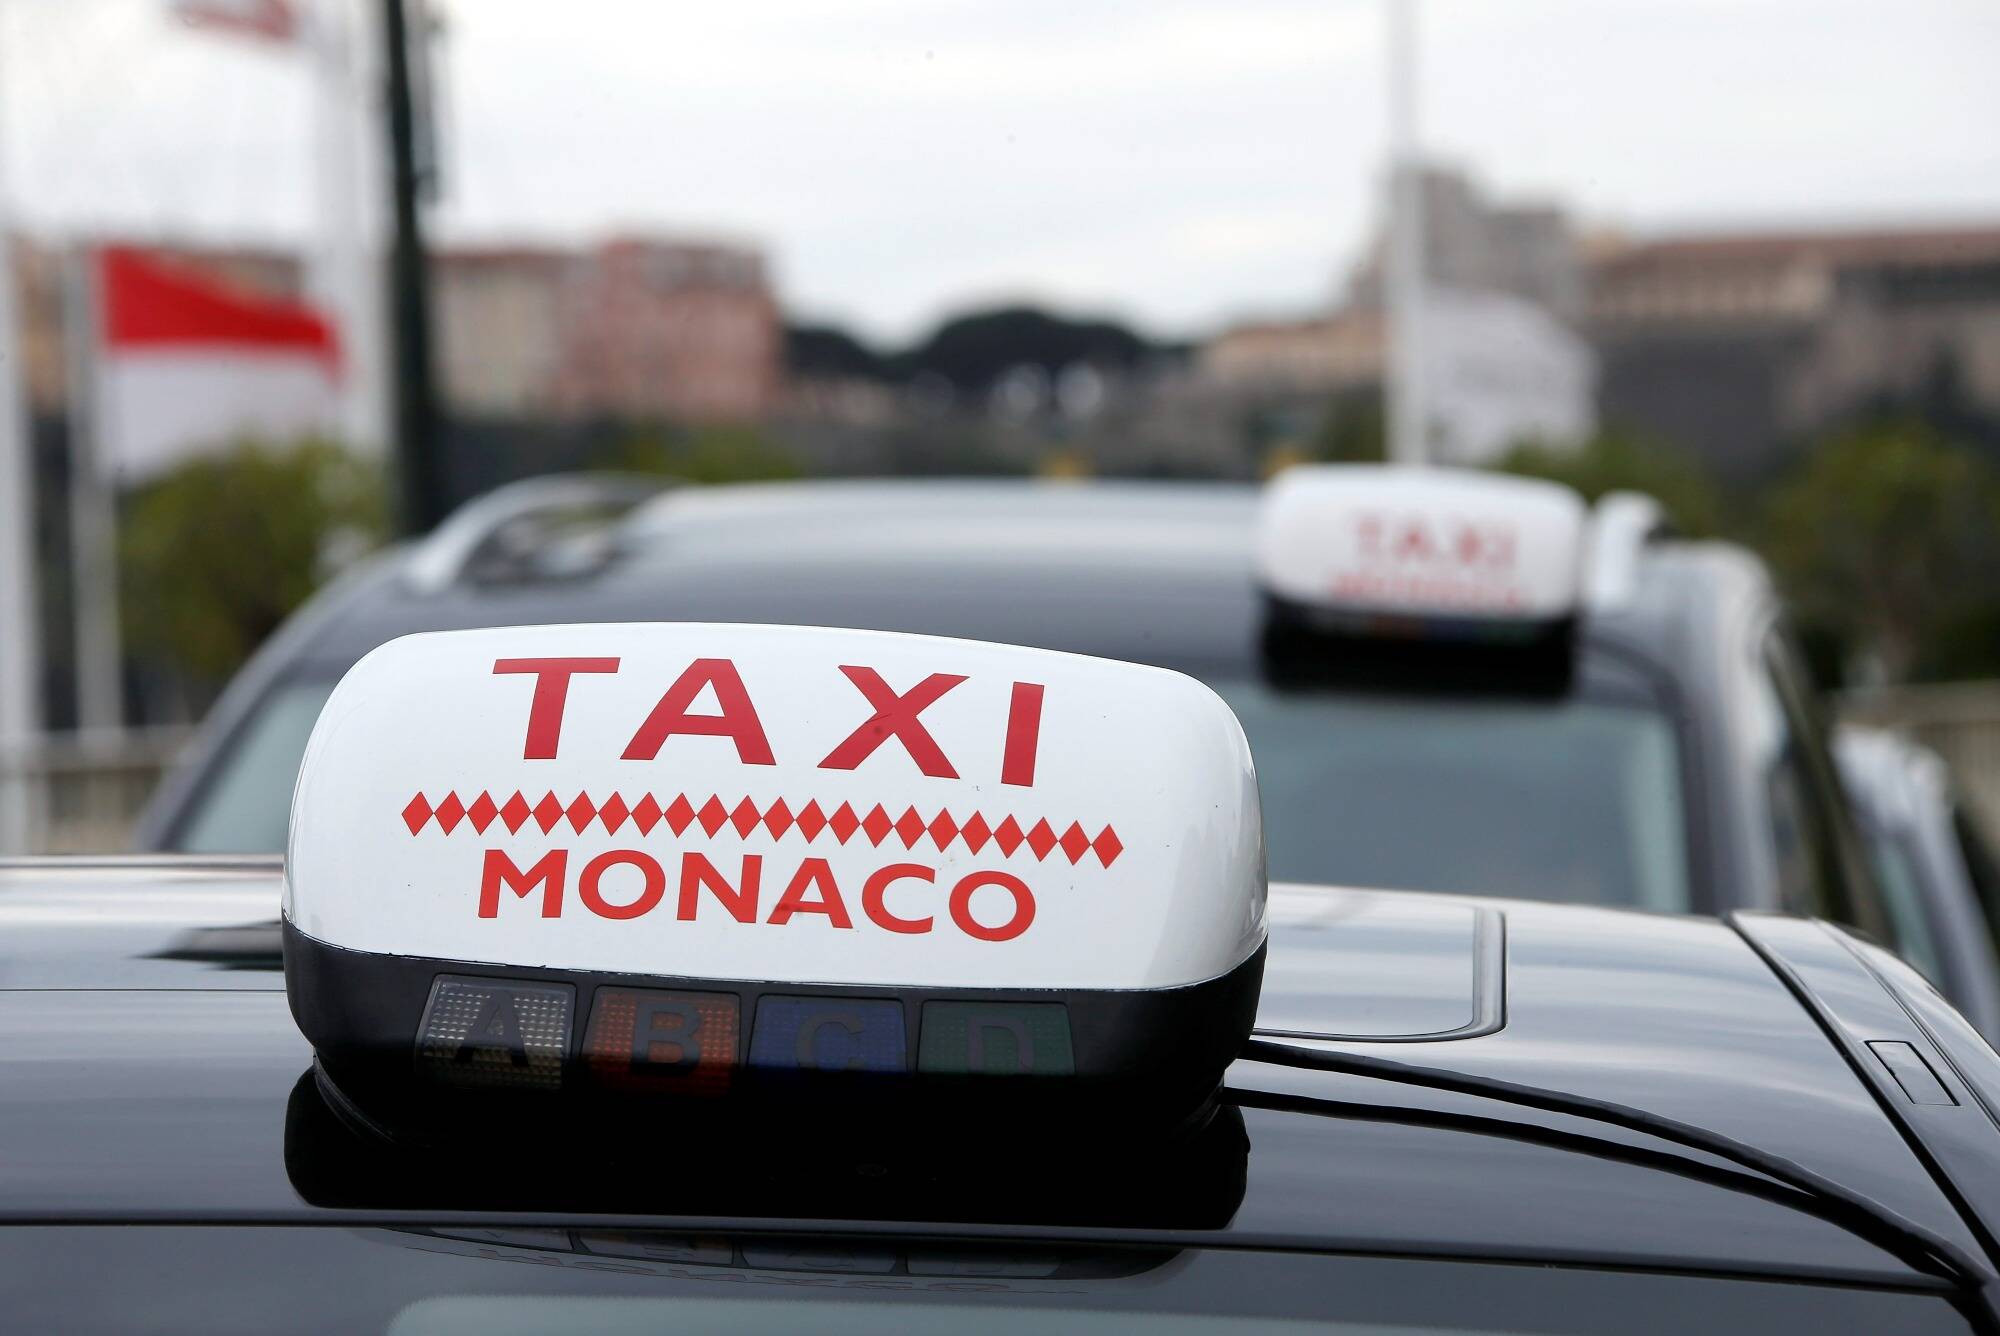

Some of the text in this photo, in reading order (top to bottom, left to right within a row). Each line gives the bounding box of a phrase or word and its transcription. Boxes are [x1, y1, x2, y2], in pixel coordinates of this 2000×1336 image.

[493, 657, 1045, 788] TAXI
[478, 848, 1037, 943] MONACO
[454, 989, 1036, 1077] A B C D
